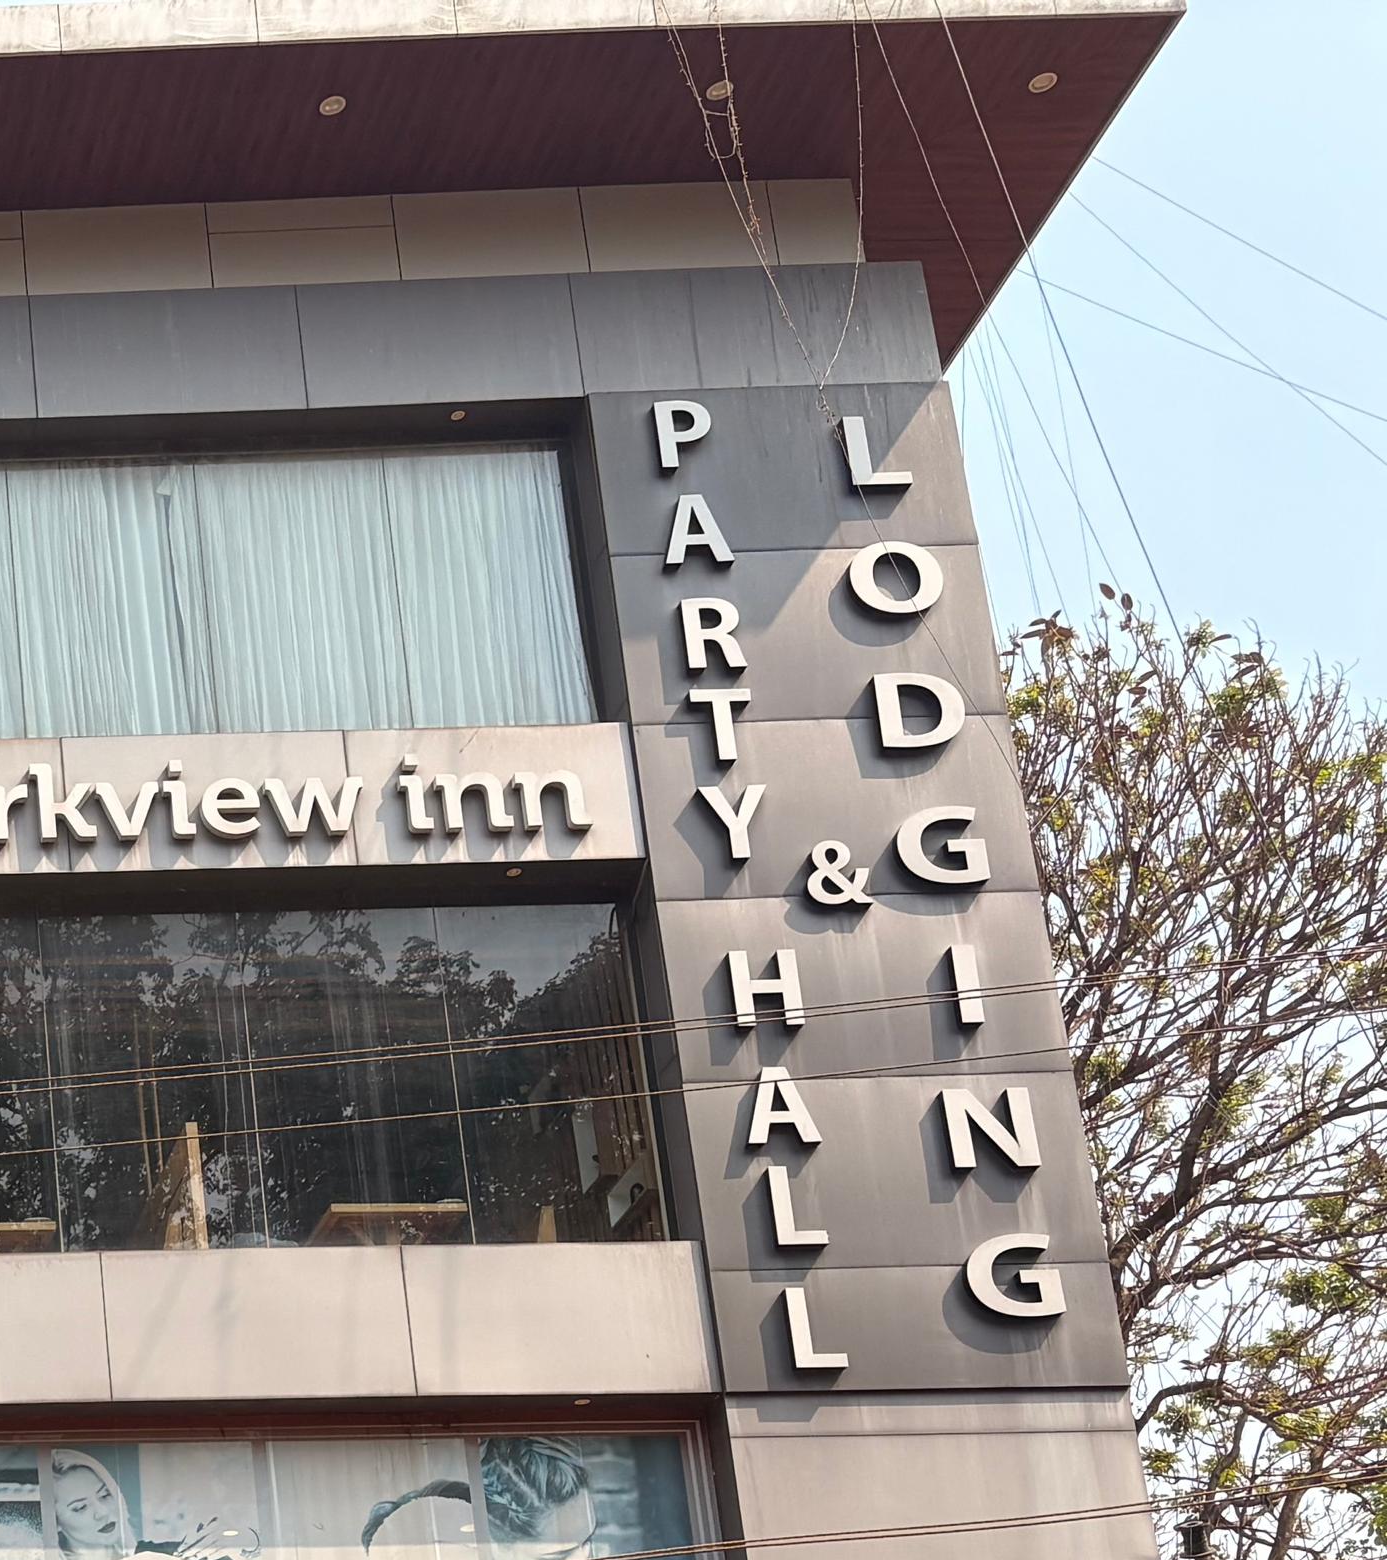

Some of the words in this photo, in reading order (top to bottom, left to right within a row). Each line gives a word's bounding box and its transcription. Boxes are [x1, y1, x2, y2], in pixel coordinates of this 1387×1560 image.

[396, 753, 594, 835] inn
[653, 399, 766, 862] PARTY
[728, 947, 850, 1372] HALL
[807, 840, 872, 906] &
[843, 416, 1066, 1319] LODGING
